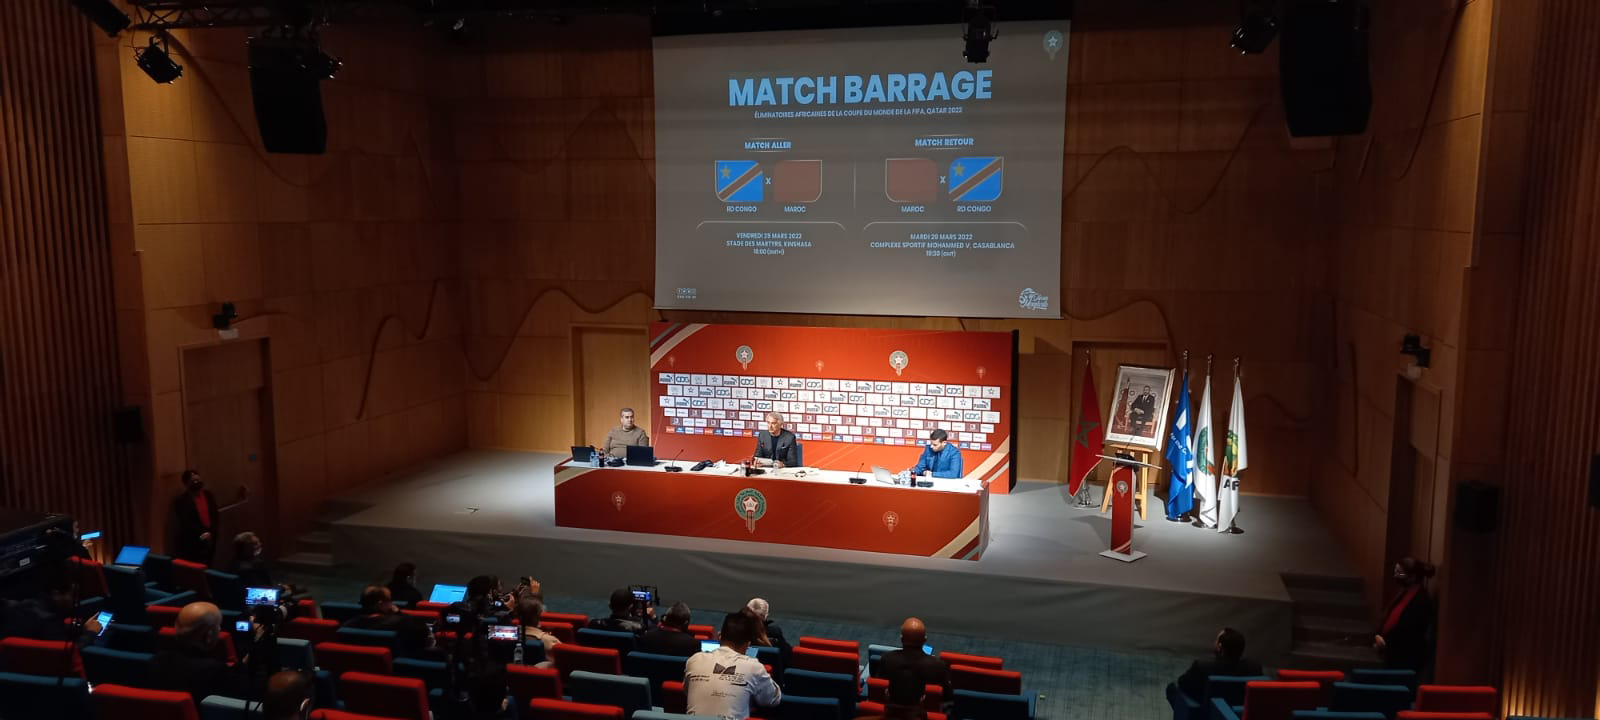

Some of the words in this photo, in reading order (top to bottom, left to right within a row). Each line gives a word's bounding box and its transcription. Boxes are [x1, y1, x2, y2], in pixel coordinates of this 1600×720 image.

[729, 76, 837, 106] MATCH
[844, 69, 993, 104] BARRAGE
[914, 138, 942, 146] MATCH
[944, 137, 974, 146] RETOUR
